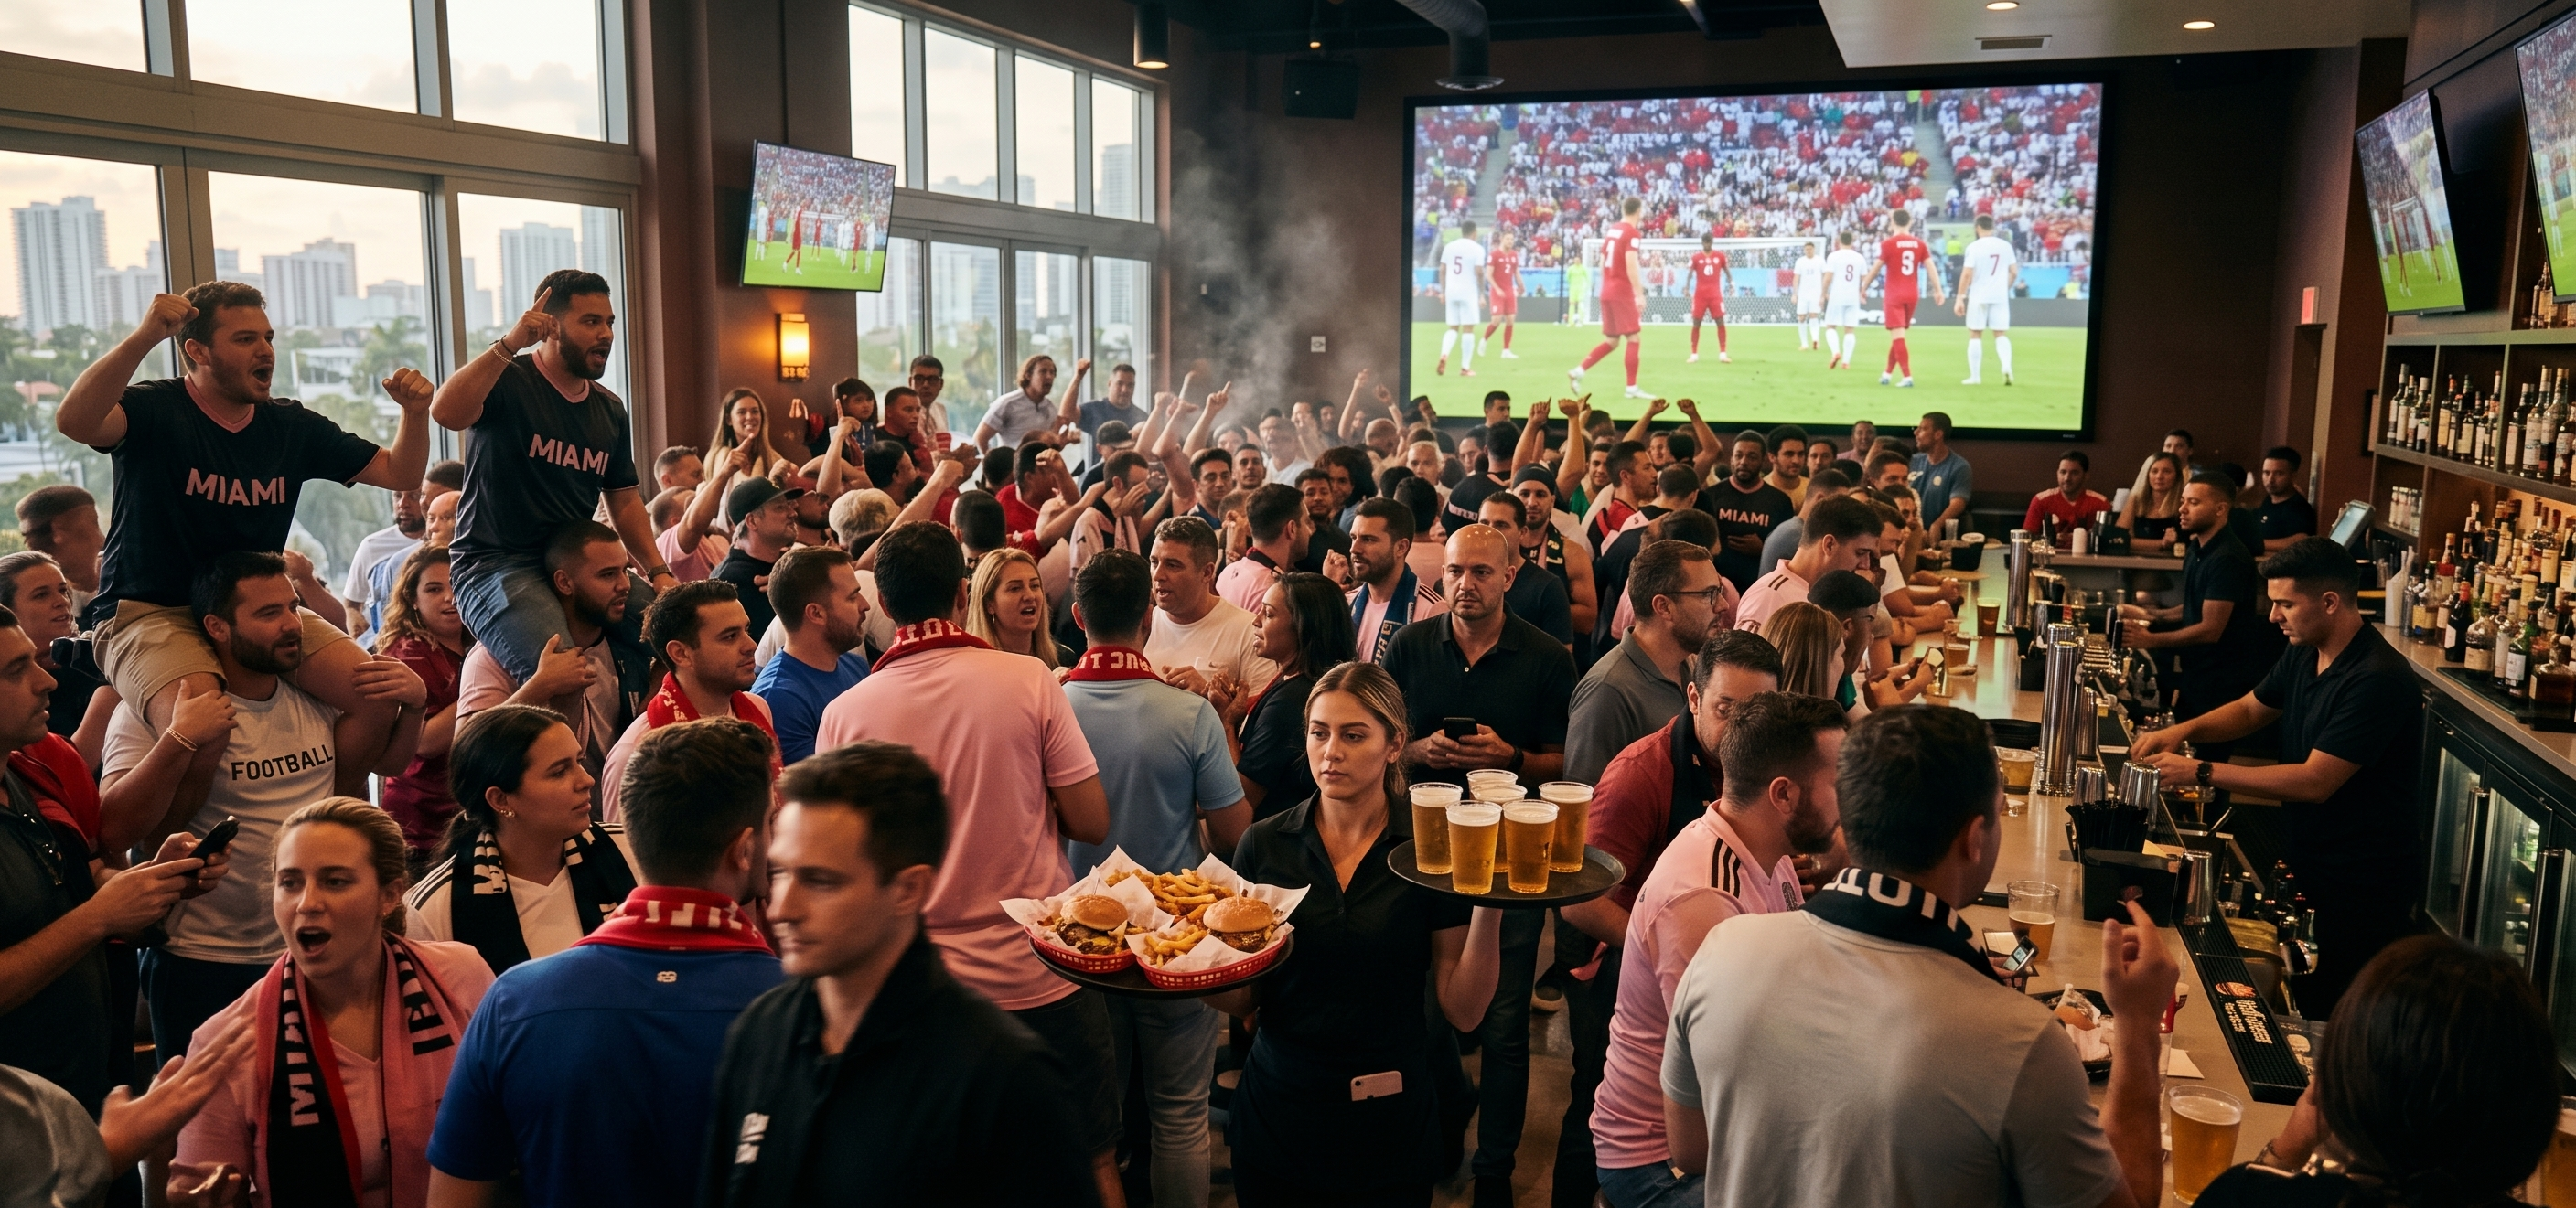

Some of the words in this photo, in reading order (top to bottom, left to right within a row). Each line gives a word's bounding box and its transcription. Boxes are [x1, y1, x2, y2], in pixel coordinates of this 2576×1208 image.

[1454, 255, 1463, 275] 5
[1990, 254, 2000, 276] 7
[529, 433, 609, 477] MIAMI
[185, 467, 285, 507] MIAMI
[1719, 508, 1769, 528] MIAMI
[231, 744, 334, 781] FOOTBALL
